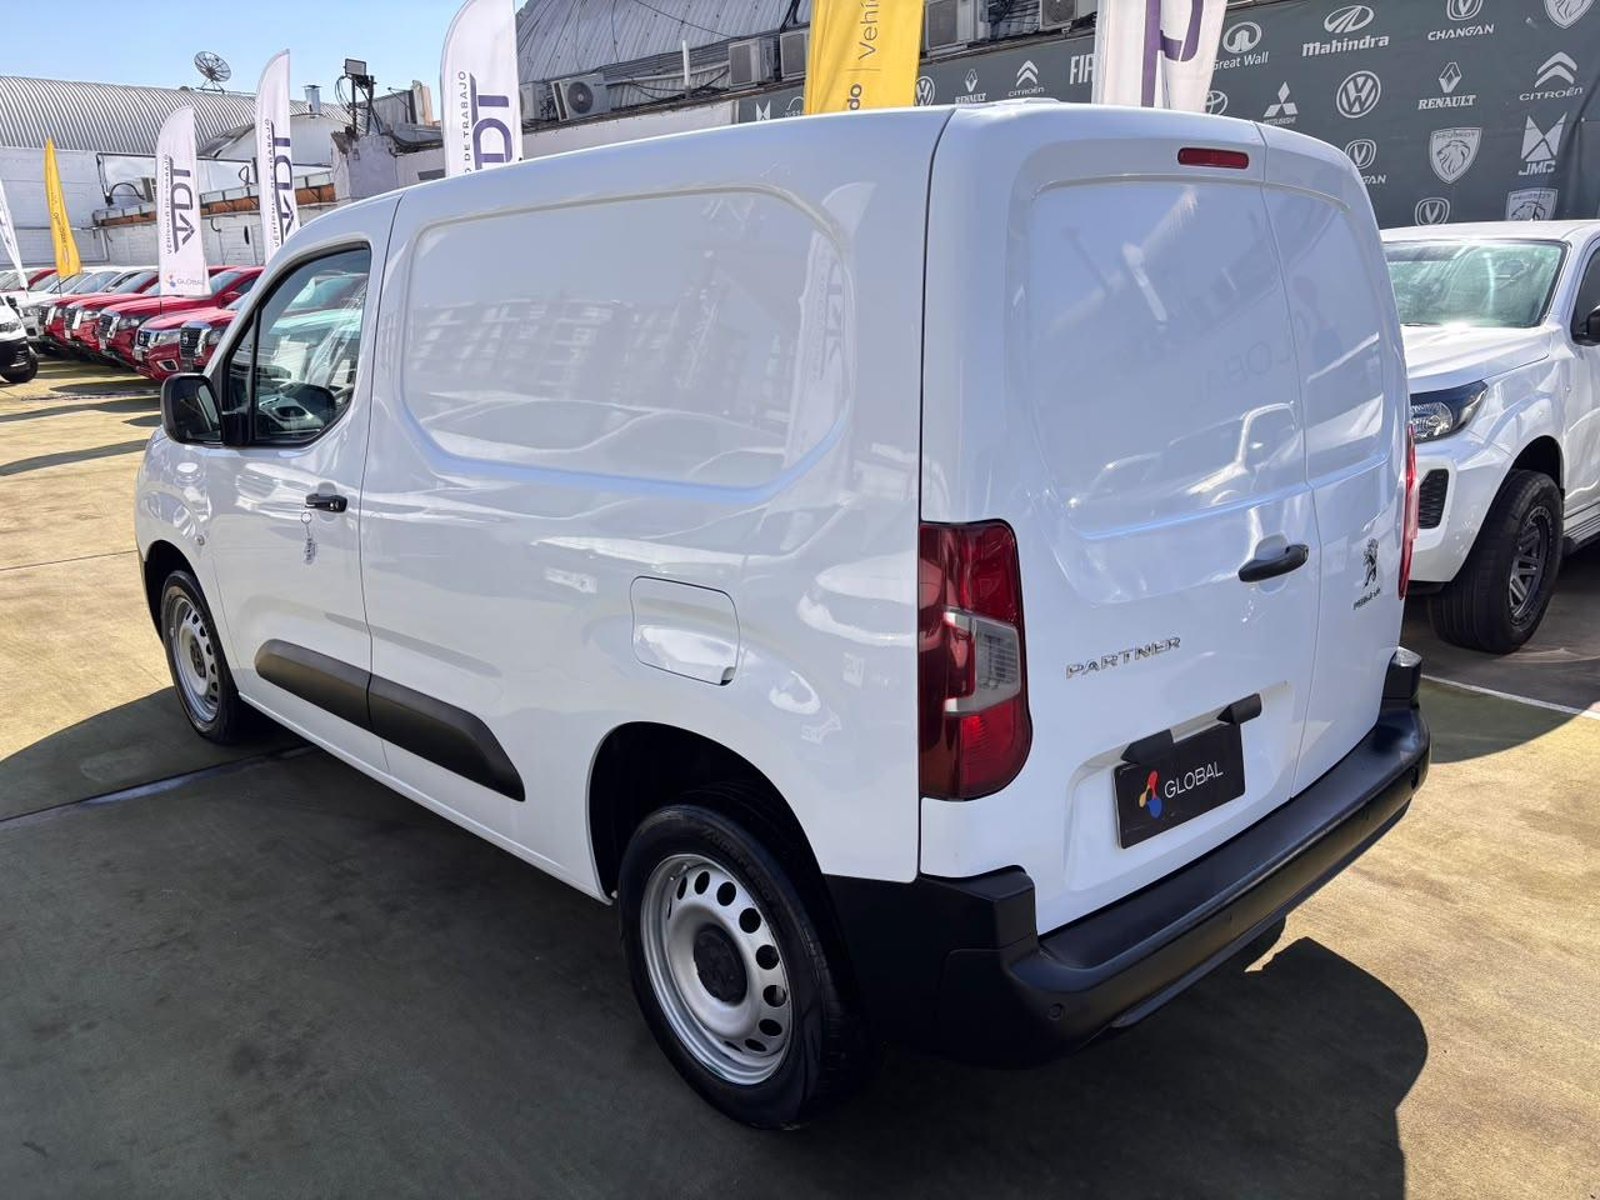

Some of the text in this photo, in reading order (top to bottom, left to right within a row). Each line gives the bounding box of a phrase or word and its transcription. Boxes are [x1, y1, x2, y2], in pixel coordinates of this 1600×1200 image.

[858, 0, 879, 60] Vehí
[1427, 24, 1494, 41] CHANGAN
[1302, 35, 1390, 56] Mahindra
[1069, 53, 1096, 85] FIA
[1244, 51, 1269, 66] Wall
[458, 71, 470, 138] TRABAJO
[1418, 95, 1477, 110] RENAULT
[463, 144, 471, 161] DE
[1518, 160, 1556, 175] JMC
[1065, 637, 1181, 679] PARTNER
[1164, 761, 1223, 799] GLOBAL
